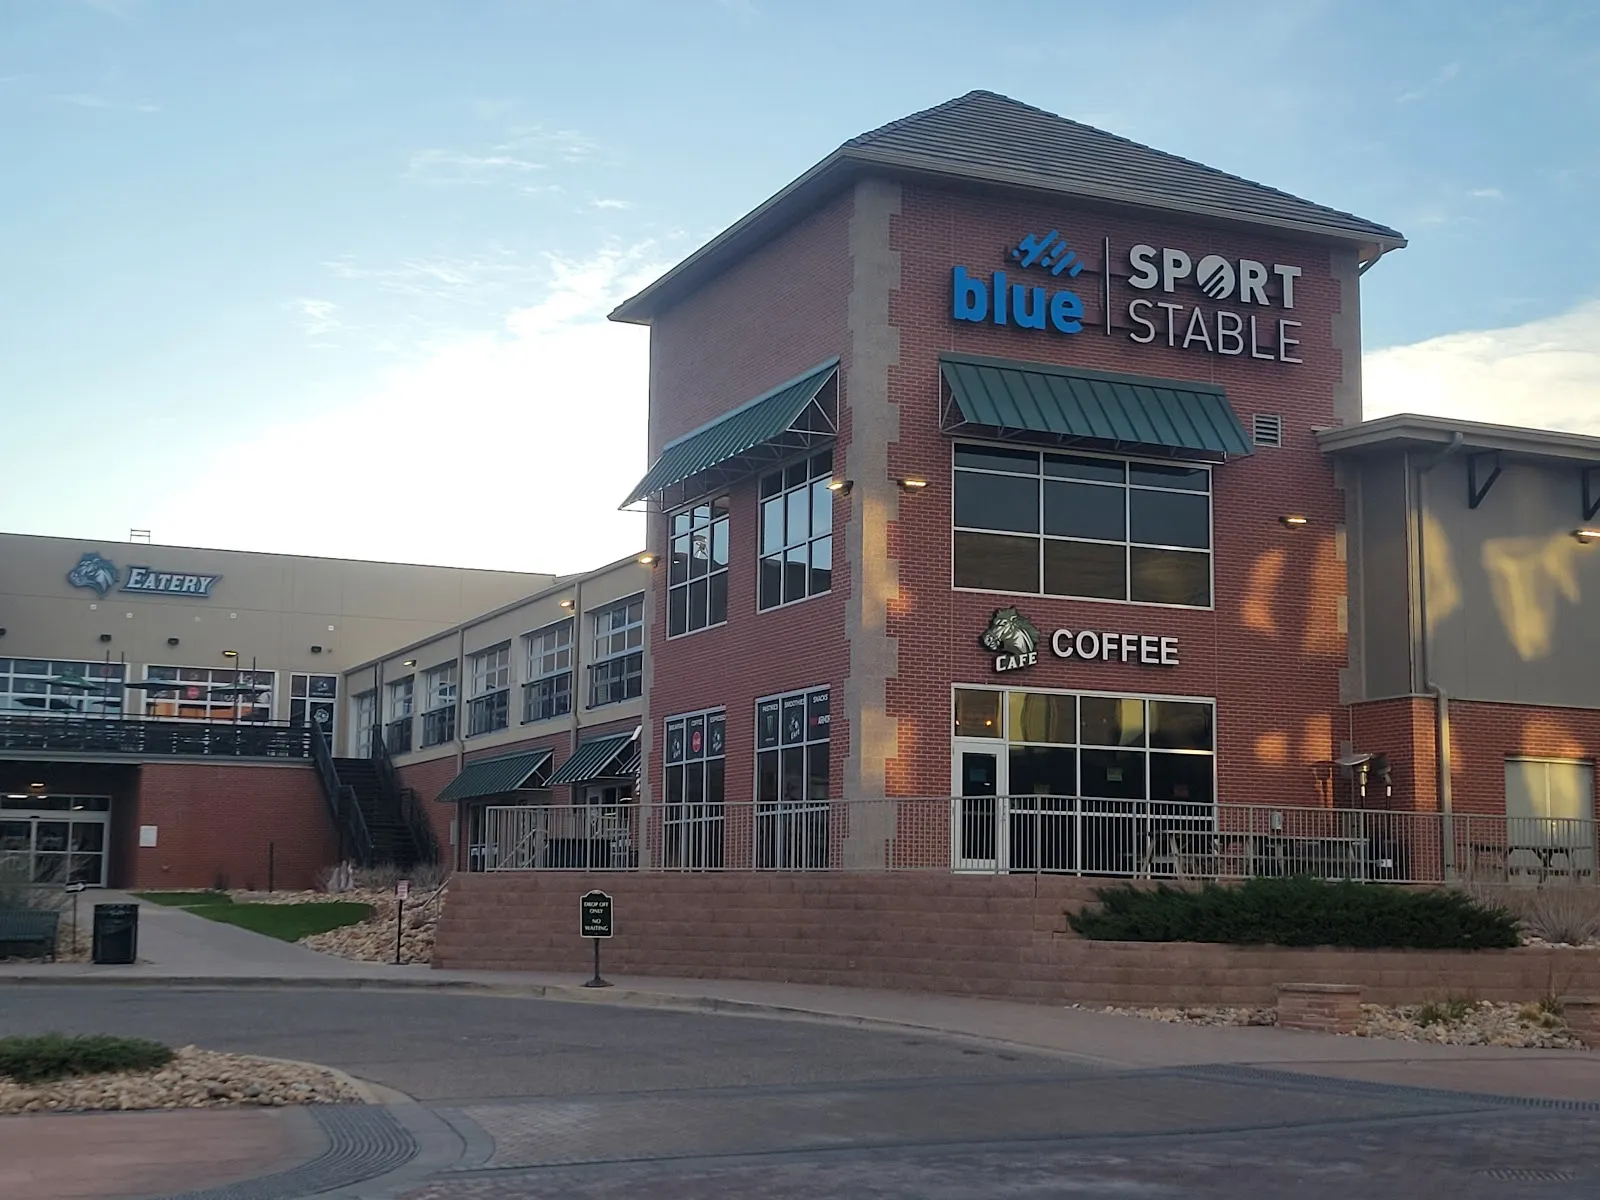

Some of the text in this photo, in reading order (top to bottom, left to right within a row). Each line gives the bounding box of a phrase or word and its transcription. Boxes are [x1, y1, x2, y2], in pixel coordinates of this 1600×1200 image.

[953, 265, 1085, 335] blue
[1127, 243, 1302, 309] SPORT
[1128, 298, 1304, 364] STABLE
[995, 651, 1038, 672] CAFE
[1052, 628, 1180, 665] COFFEE
